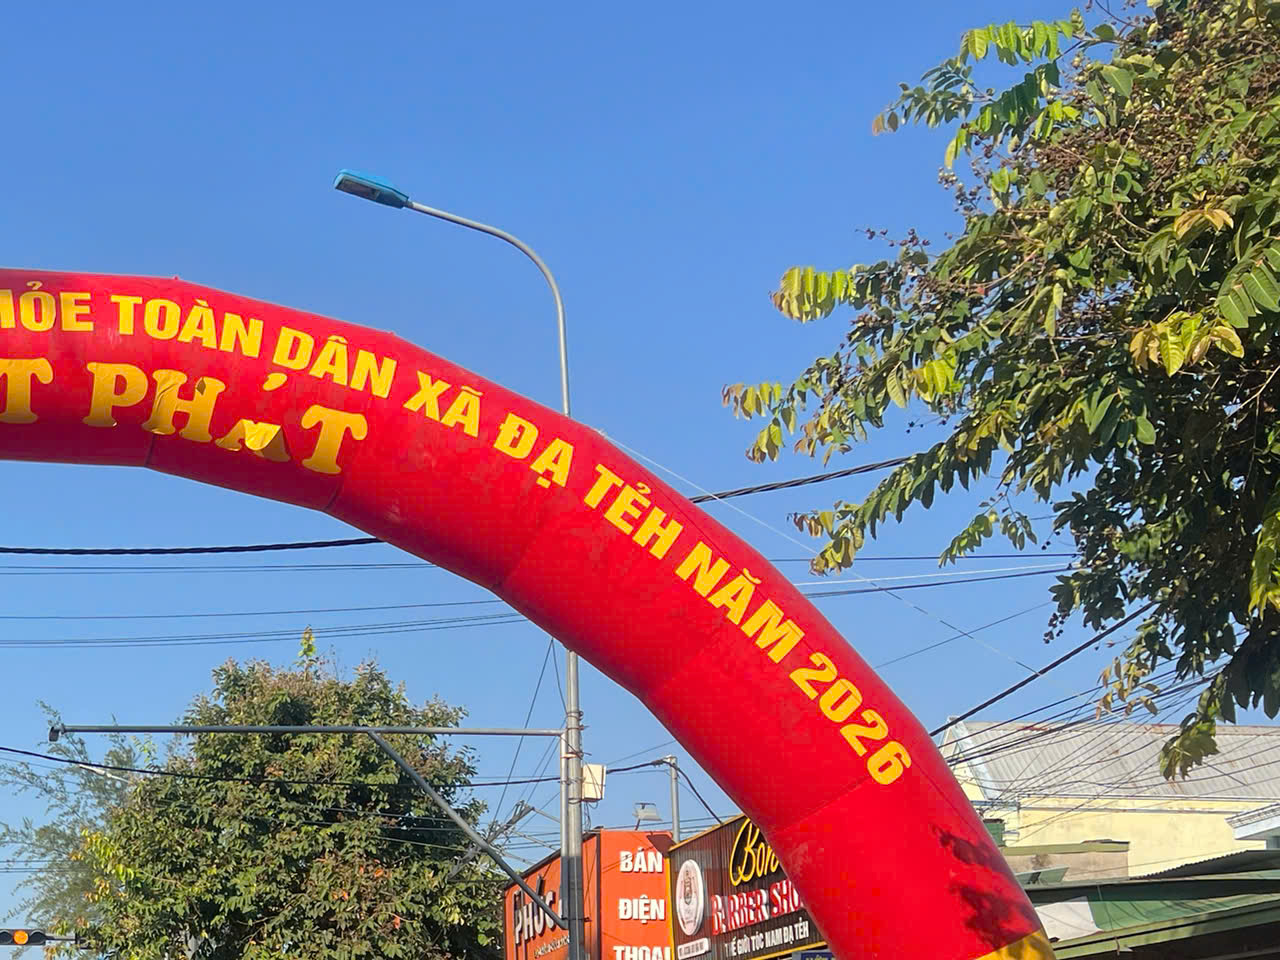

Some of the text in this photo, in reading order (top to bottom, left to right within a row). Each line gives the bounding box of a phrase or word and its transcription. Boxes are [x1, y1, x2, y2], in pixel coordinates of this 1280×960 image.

[110, 294, 264, 358] TOÀN
[272, 326, 398, 399] DÂN
[403, 370, 483, 438] XÃ
[493, 413, 574, 489] ĐẠ
[583, 464, 684, 560] TẺH
[674, 541, 806, 664] NĂM
[789, 652, 913, 786] 2026
[619, 846, 663, 873] BÁN
[618, 893, 666, 924] ĐIỆN
[770, 880, 802, 918] SHO
[765, 928, 783, 948] NAM
